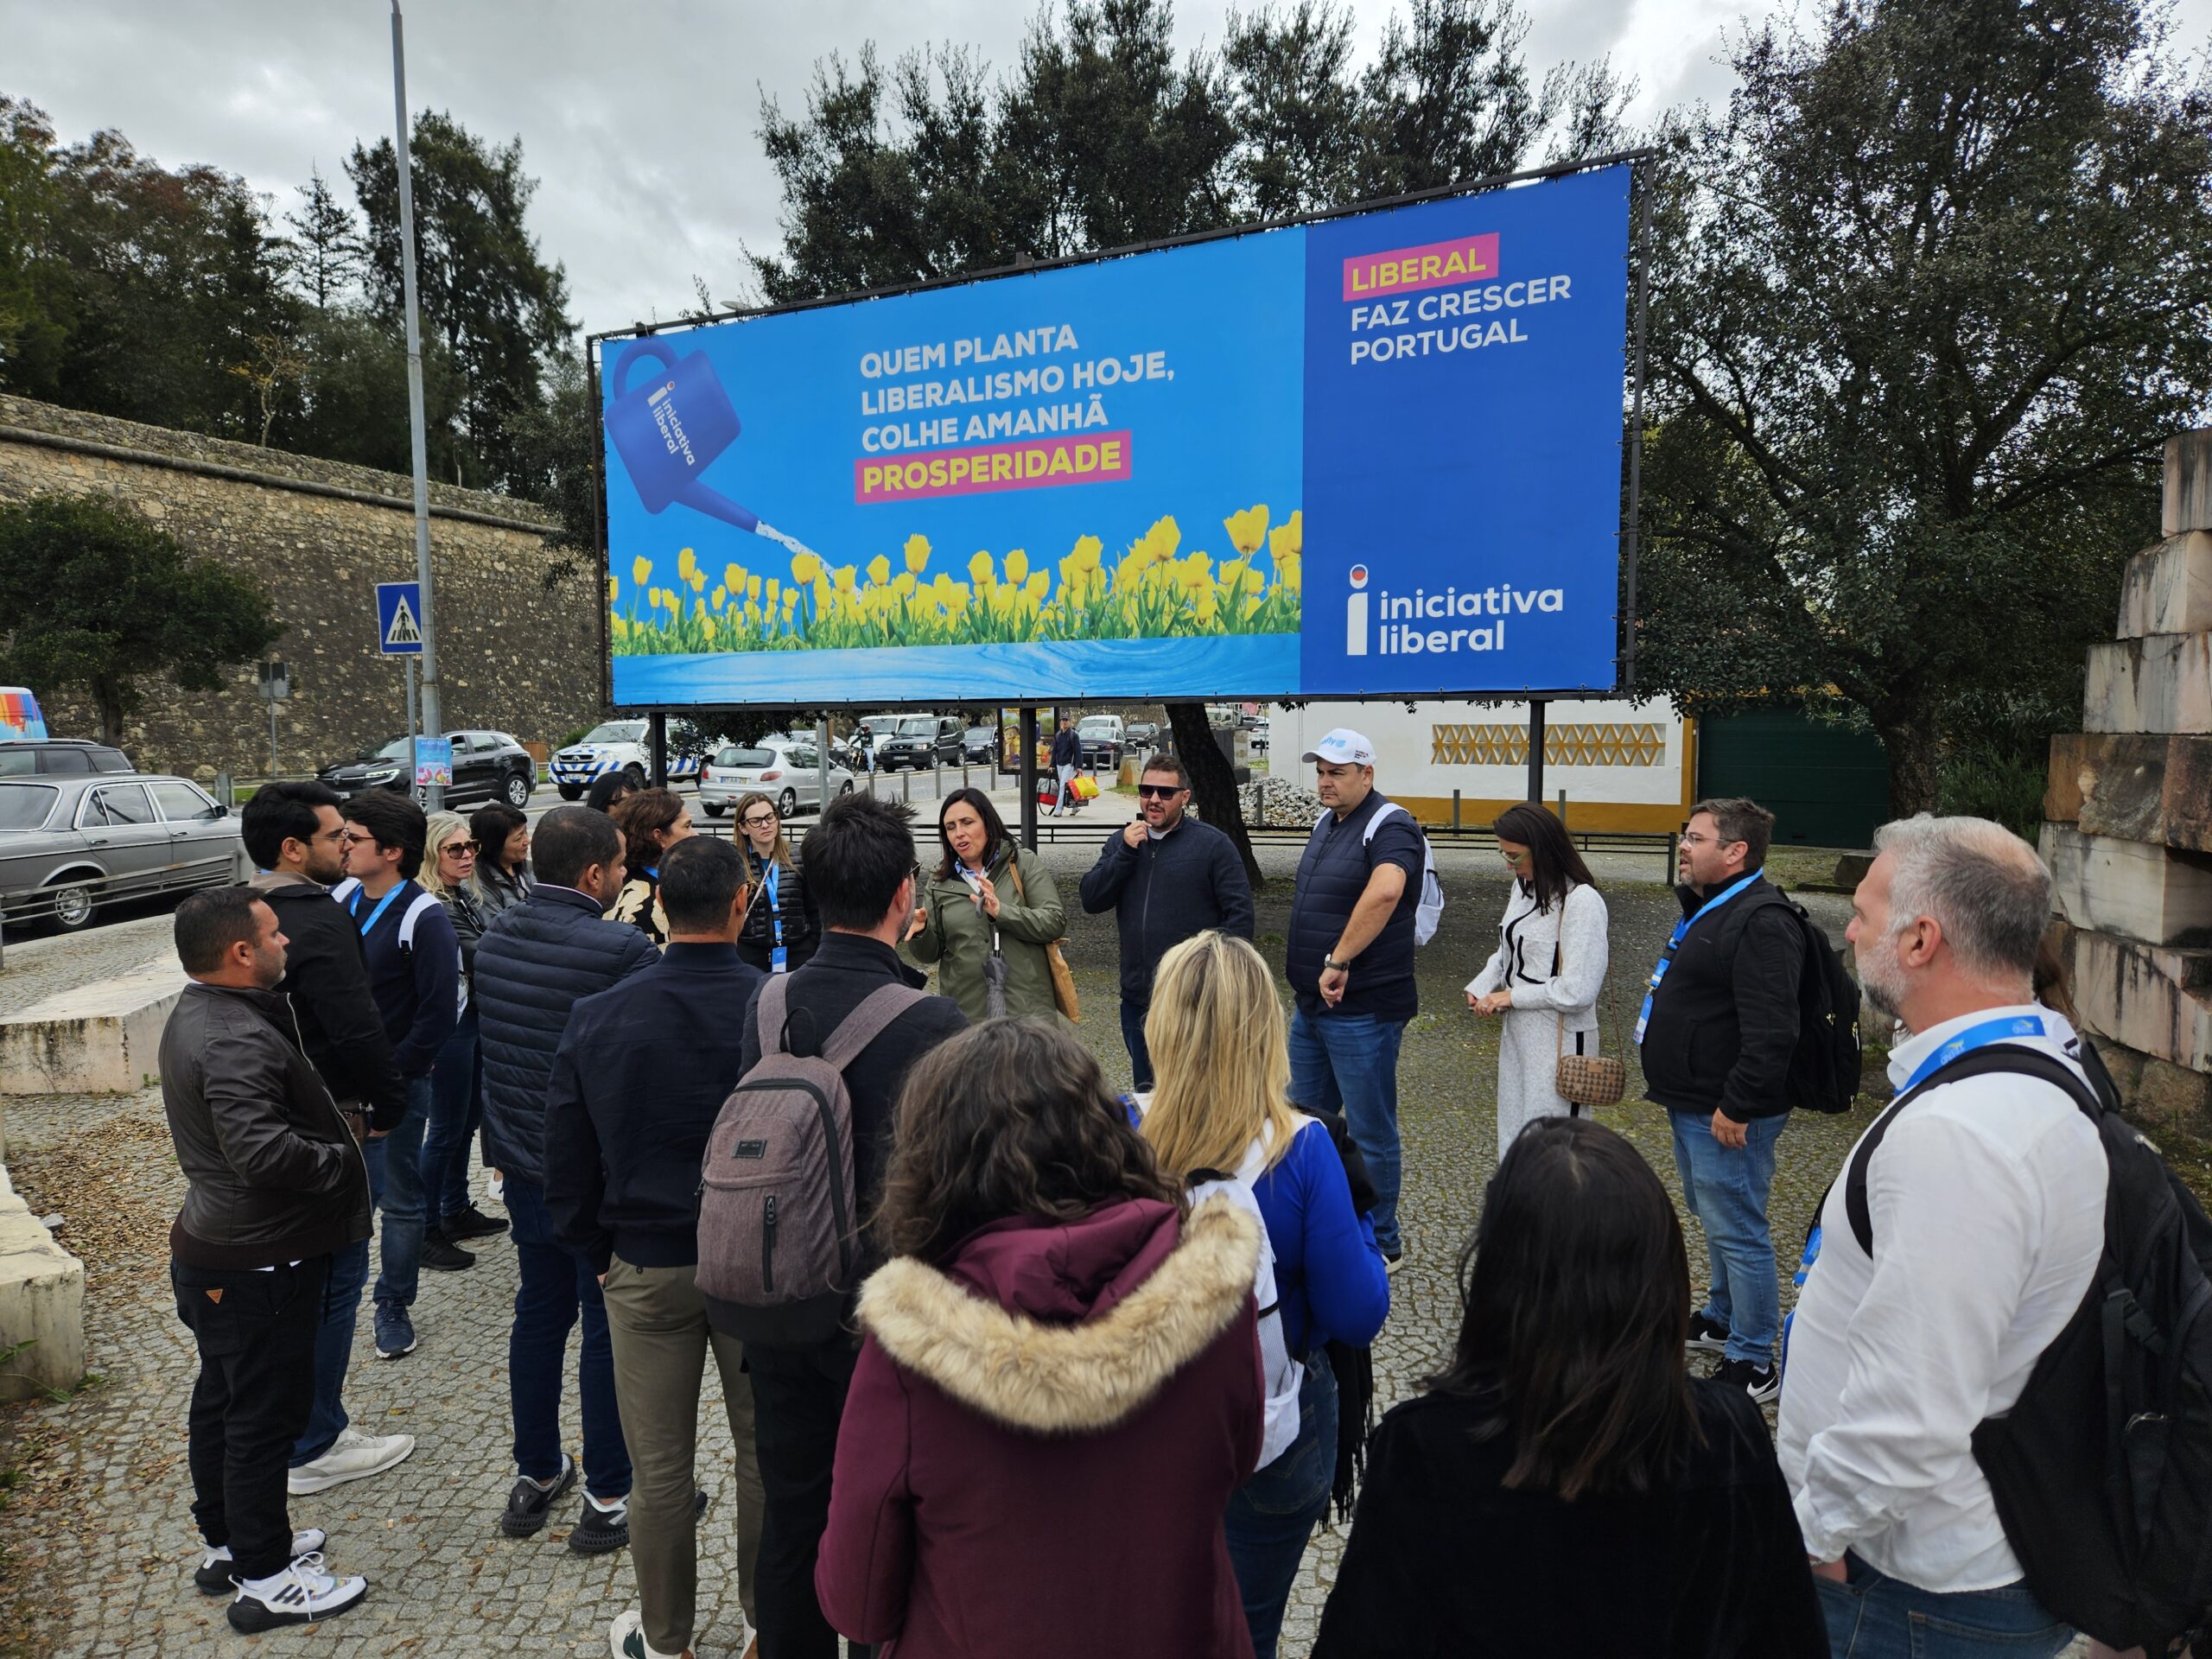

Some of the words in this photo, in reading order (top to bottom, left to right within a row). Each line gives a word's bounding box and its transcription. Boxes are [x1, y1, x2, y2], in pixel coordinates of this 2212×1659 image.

[1352, 248, 1486, 292] LIBERAL
[1351, 300, 1409, 332] FAZ
[1418, 275, 1572, 321] CRESCER
[860, 343, 946, 378] QUEM
[954, 324, 1079, 365] PLANTA
[1351, 318, 1529, 365] PORTUGAL
[861, 365, 1065, 416] LIBERALISMO
[1073, 351, 1174, 389] HOJE,
[652, 405, 680, 454] liberal
[662, 398, 696, 466] iniciativa
[861, 417, 959, 452] COLHE
[963, 393, 1109, 441] AMANHÃ
[864, 441, 1122, 493] PROSPERIDADE
[1381, 583, 1563, 620] iniciativa
[1380, 620, 1505, 655] liberal
